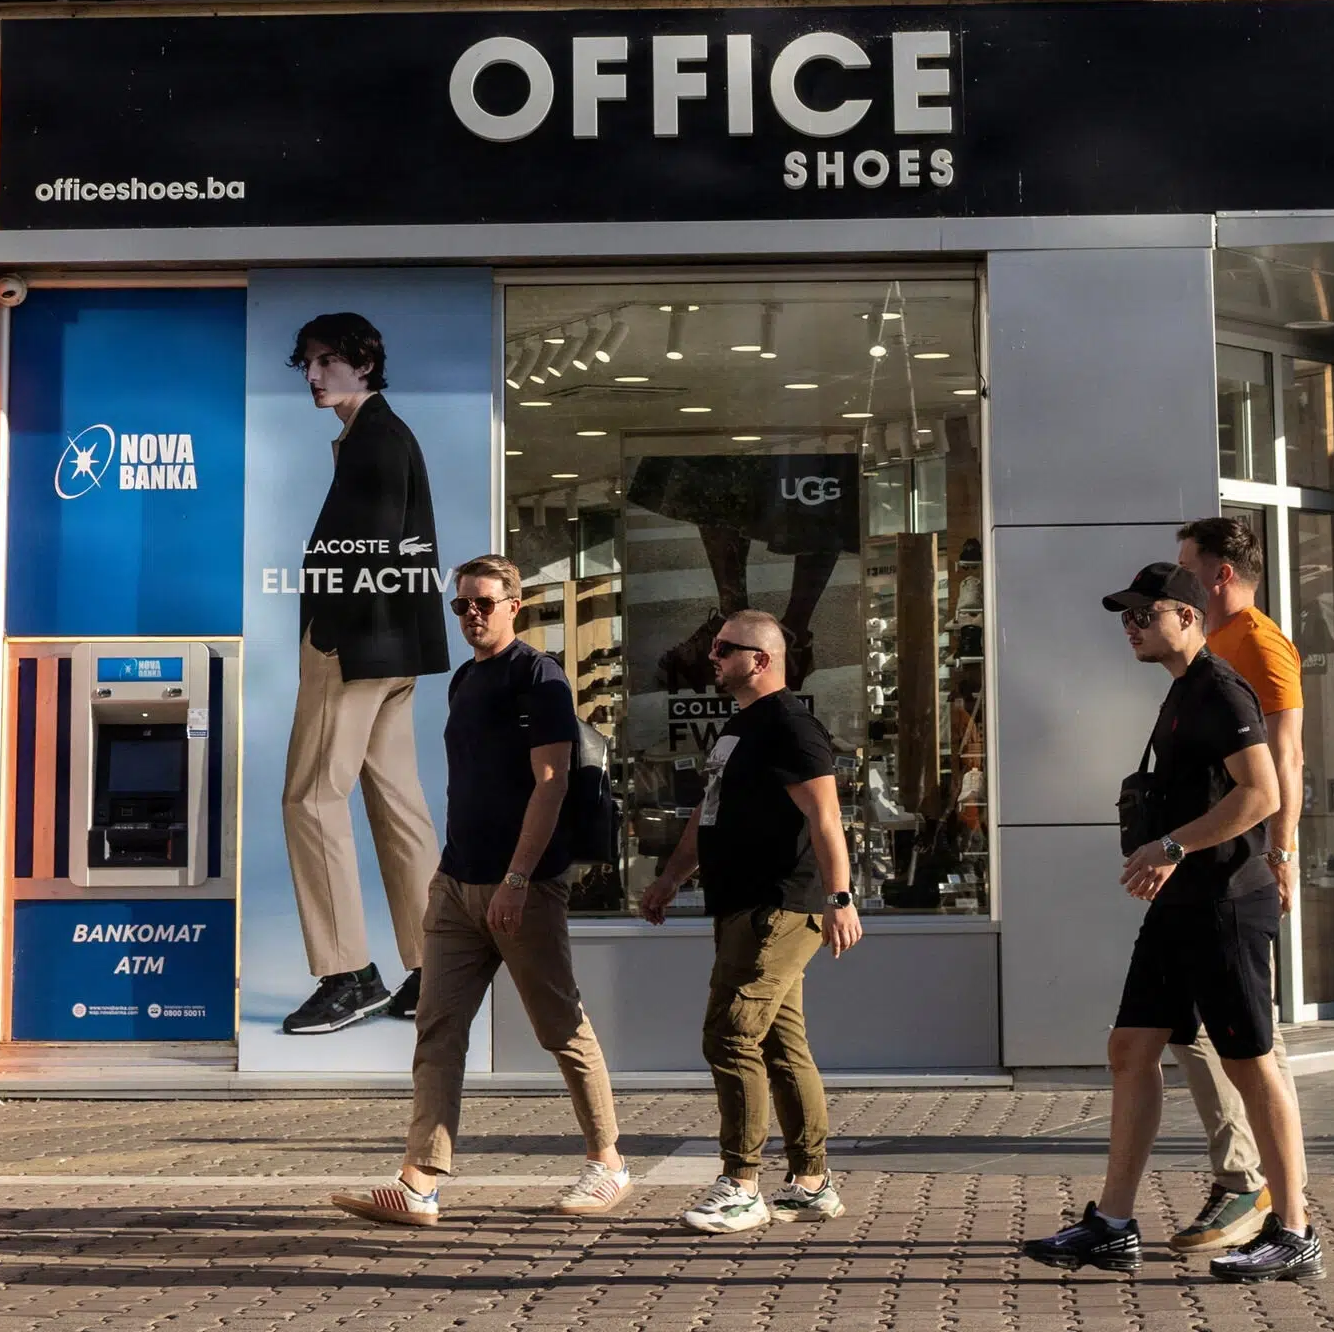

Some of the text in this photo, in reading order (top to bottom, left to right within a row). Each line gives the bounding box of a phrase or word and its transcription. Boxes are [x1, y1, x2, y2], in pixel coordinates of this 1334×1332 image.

[449, 31, 953, 143] OFFICE
[782, 148, 955, 189] SHOES
[34, 176, 245, 203] officeshoes.ba
[120, 434, 194, 464] NOVA
[119, 465, 198, 490] BANKA
[780, 475, 841, 506] UGG
[303, 539, 390, 554] LACOSTE
[263, 568, 344, 594] ELITE
[72, 923, 206, 943] BANKOMAT
[114, 955, 165, 975] ATM
